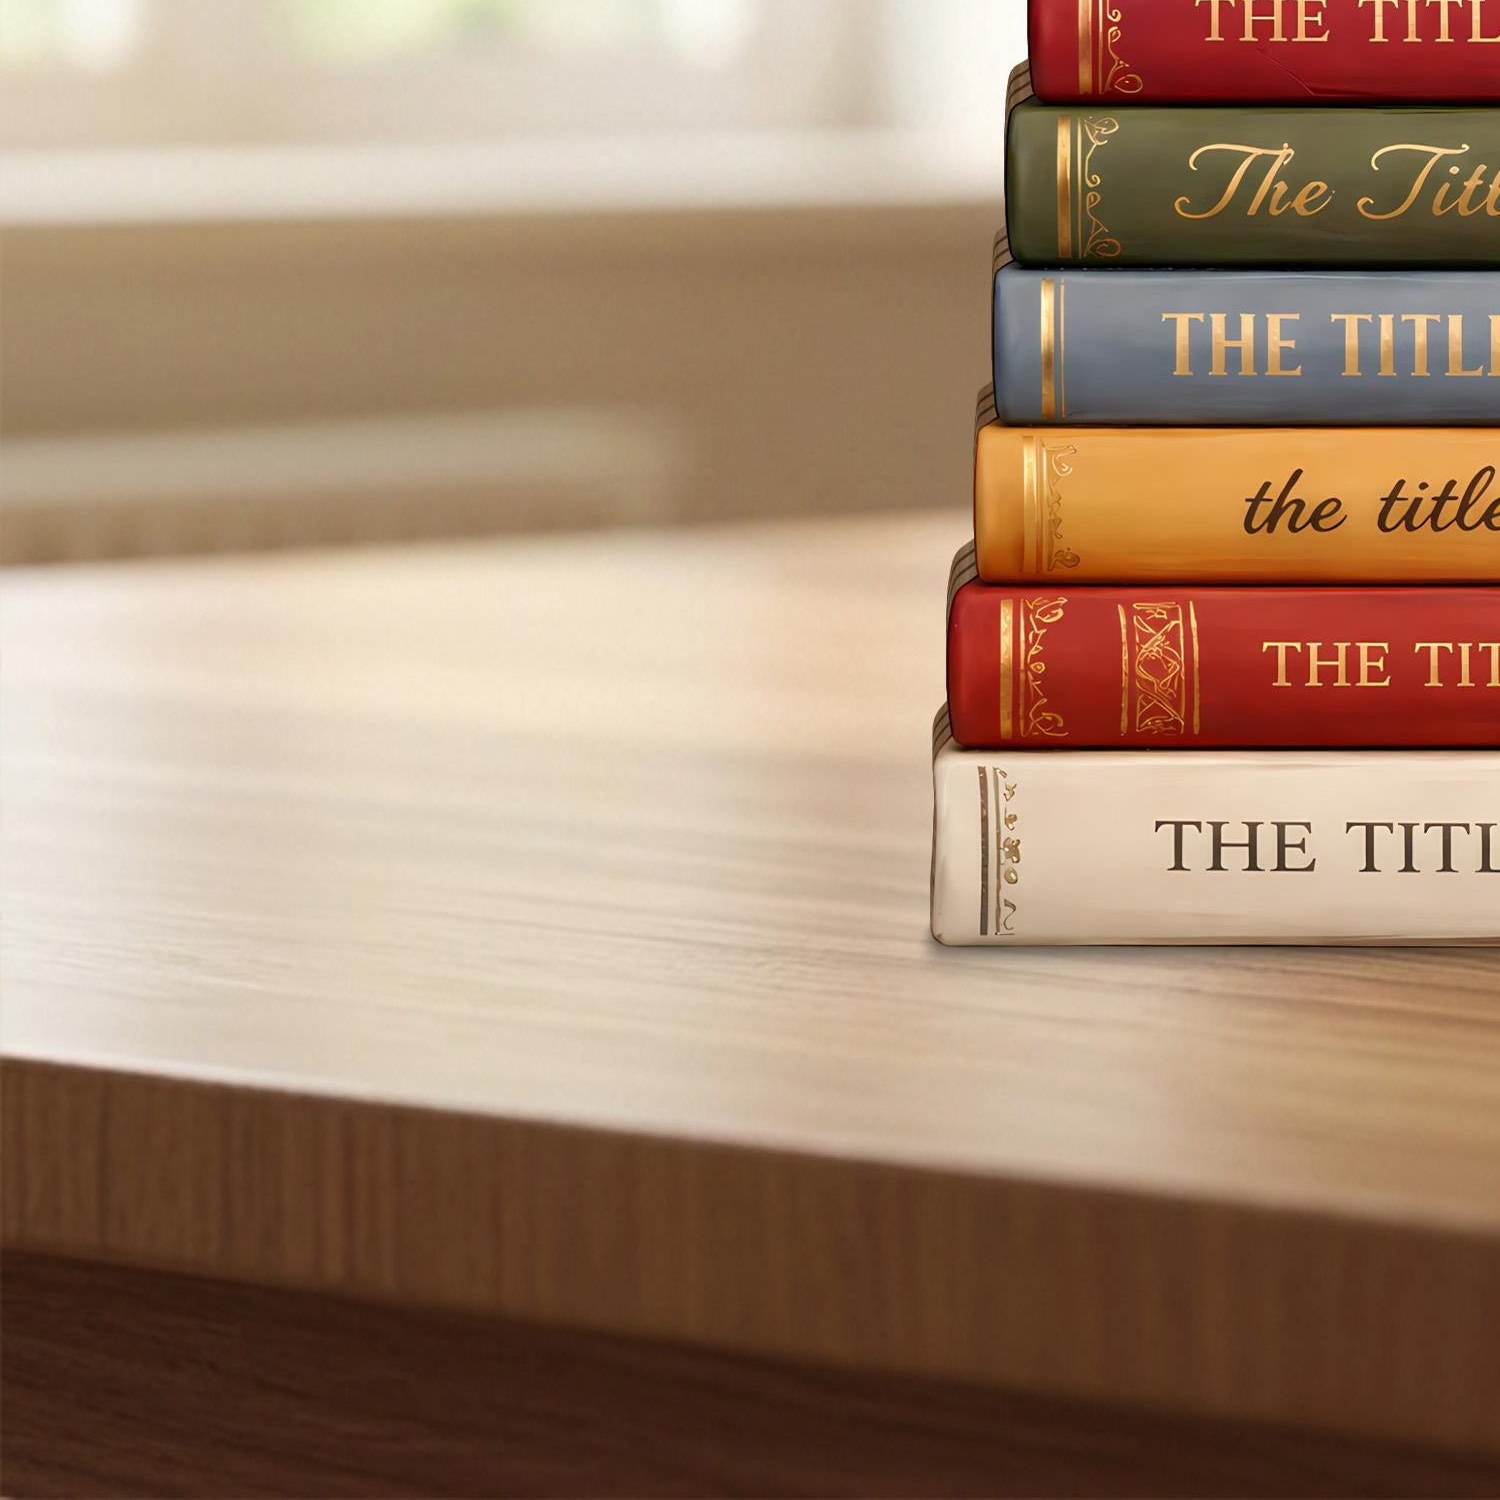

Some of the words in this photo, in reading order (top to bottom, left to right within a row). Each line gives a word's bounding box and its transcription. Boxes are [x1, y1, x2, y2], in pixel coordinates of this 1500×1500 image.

[1175, 143, 1332, 218] The
[1161, 312, 1301, 375] THE
[1244, 469, 1347, 534] the
[1263, 642, 1390, 686] THE
[1155, 821, 1316, 872] THE
